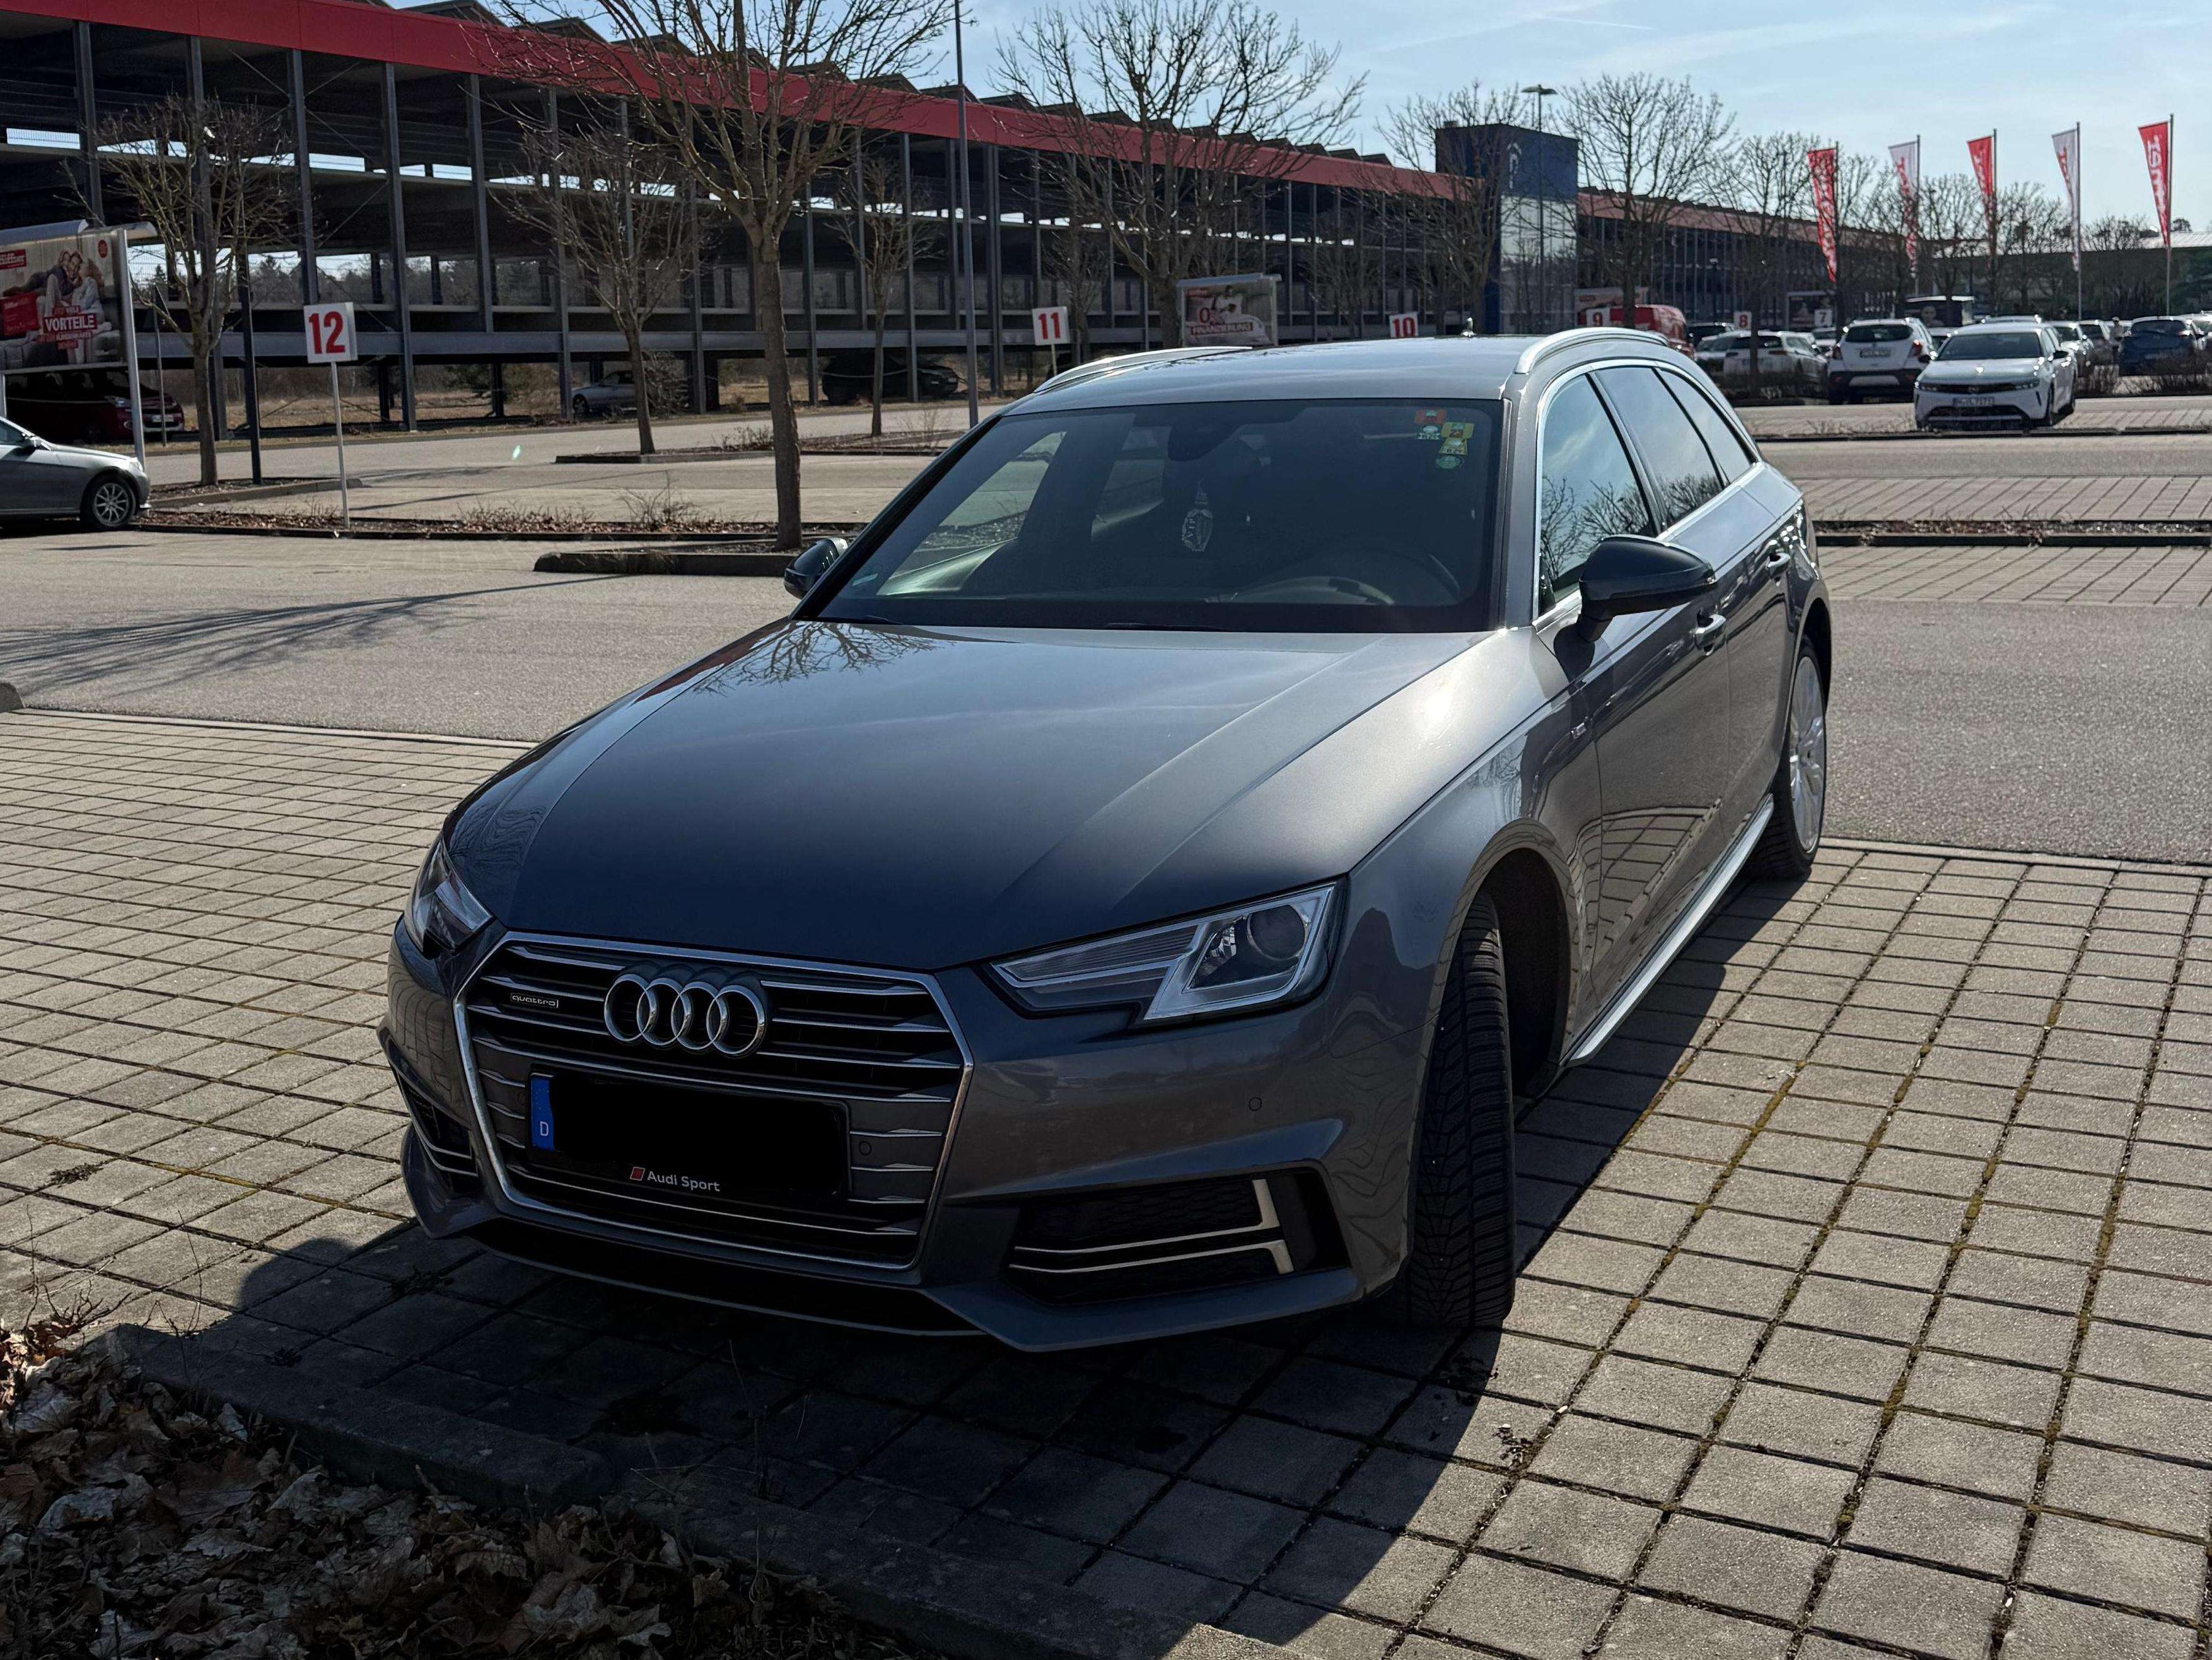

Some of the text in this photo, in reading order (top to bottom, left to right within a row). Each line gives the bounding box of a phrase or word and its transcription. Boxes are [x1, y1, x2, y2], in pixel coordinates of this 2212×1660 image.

[44, 314, 95, 332] VORTEILE
[1039, 312, 1061, 339] 11
[1393, 317, 1416, 338] 10
[1820, 312, 1827, 324] 7
[309, 311, 346, 354] 12
[511, 995, 556, 1007] quattro
[540, 1121, 549, 1136] D
[647, 1171, 720, 1192] Audi Sport
